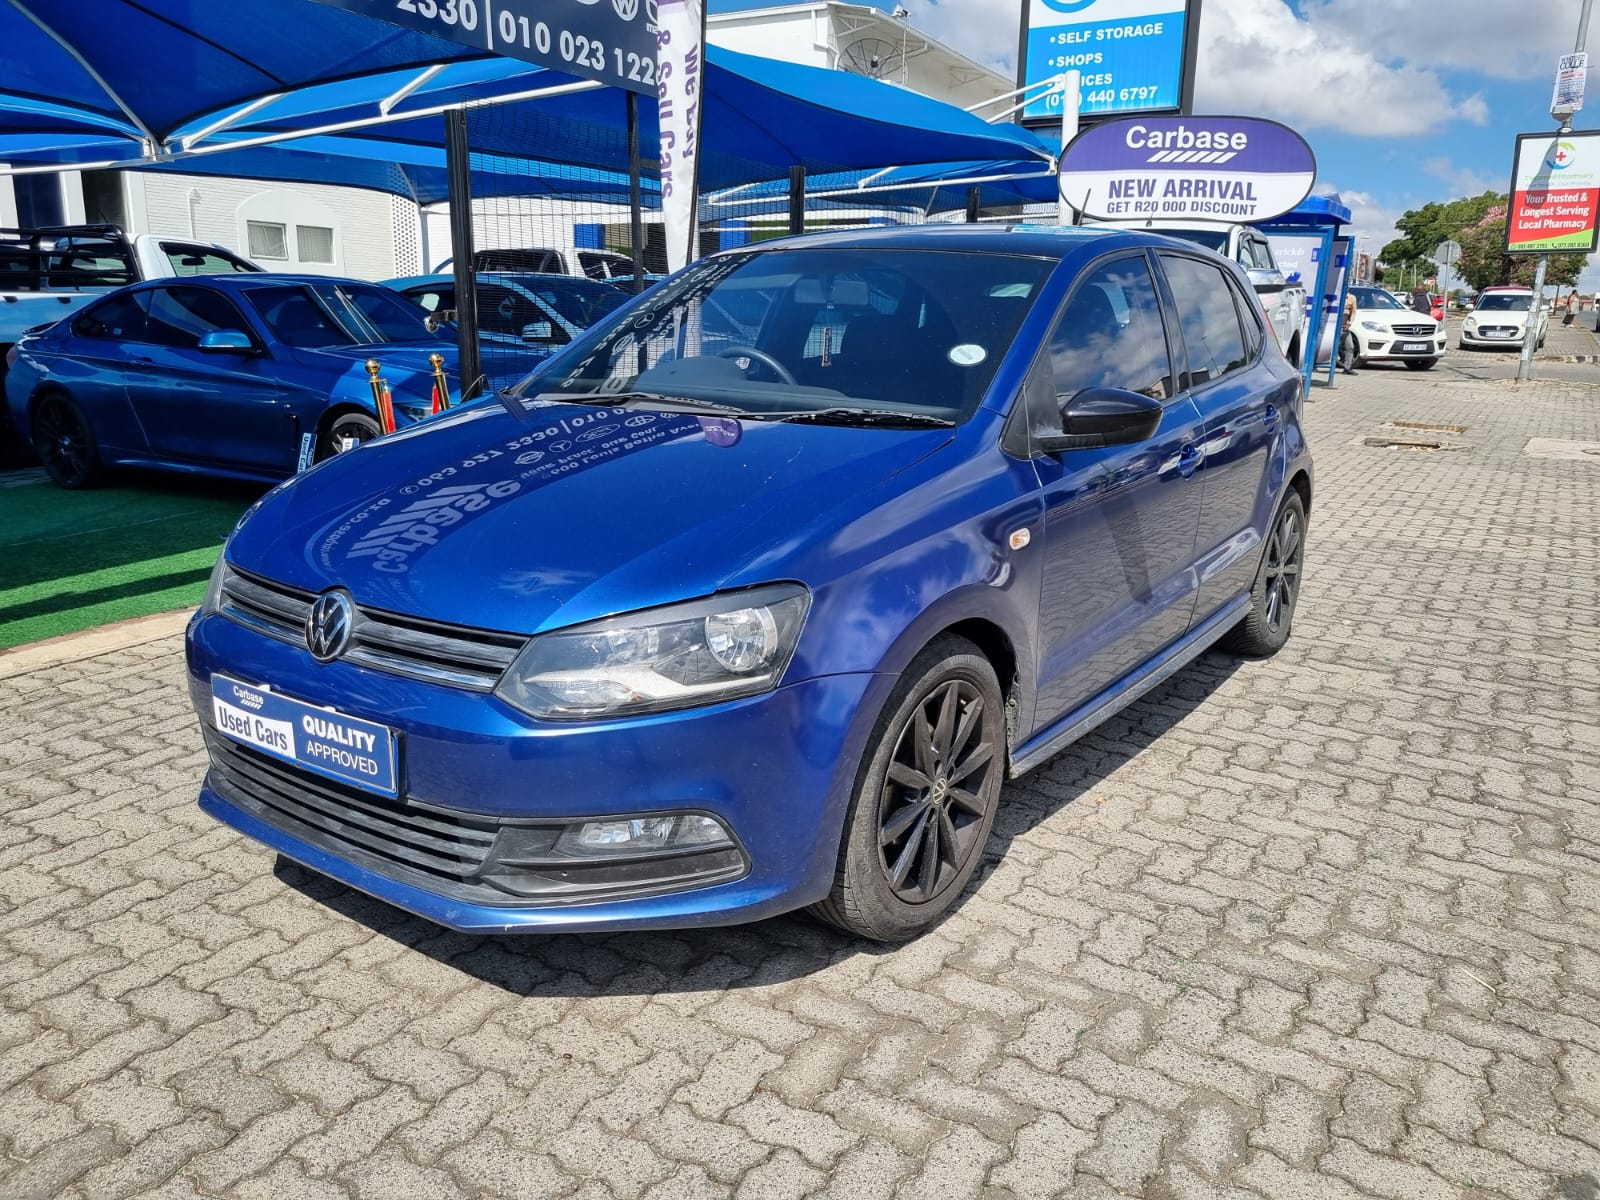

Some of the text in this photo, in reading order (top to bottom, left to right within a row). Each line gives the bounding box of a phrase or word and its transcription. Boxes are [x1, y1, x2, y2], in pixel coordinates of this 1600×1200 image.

[1058, 22, 1163, 44] SELF STORAGE
[500, 10, 550, 54] 010
[560, 30, 606, 71] 023
[614, 48, 658, 87] 122
[1056, 52, 1103, 67] SHOPS
[684, 42, 698, 96] We
[1081, 73, 1112, 87] ICES
[1088, 89, 1115, 104] 440
[1120, 86, 1158, 102] 6797
[1125, 125, 1248, 150] Carbase
[659, 130, 675, 199] Cars
[1108, 179, 1257, 201] NEW ARRIVAL
[1526, 192, 1588, 204] Your Trusted &
[1106, 201, 1257, 216] GET R20 000 DISCOUNT
[1520, 206, 1589, 218] Longest Serving
[1519, 219, 1587, 230] Local Pharmacy
[233, 685, 264, 705] Carbase
[219, 704, 288, 750] Used Cars
[302, 714, 376, 752] QUALITY
[306, 741, 378, 775] APPROVED
